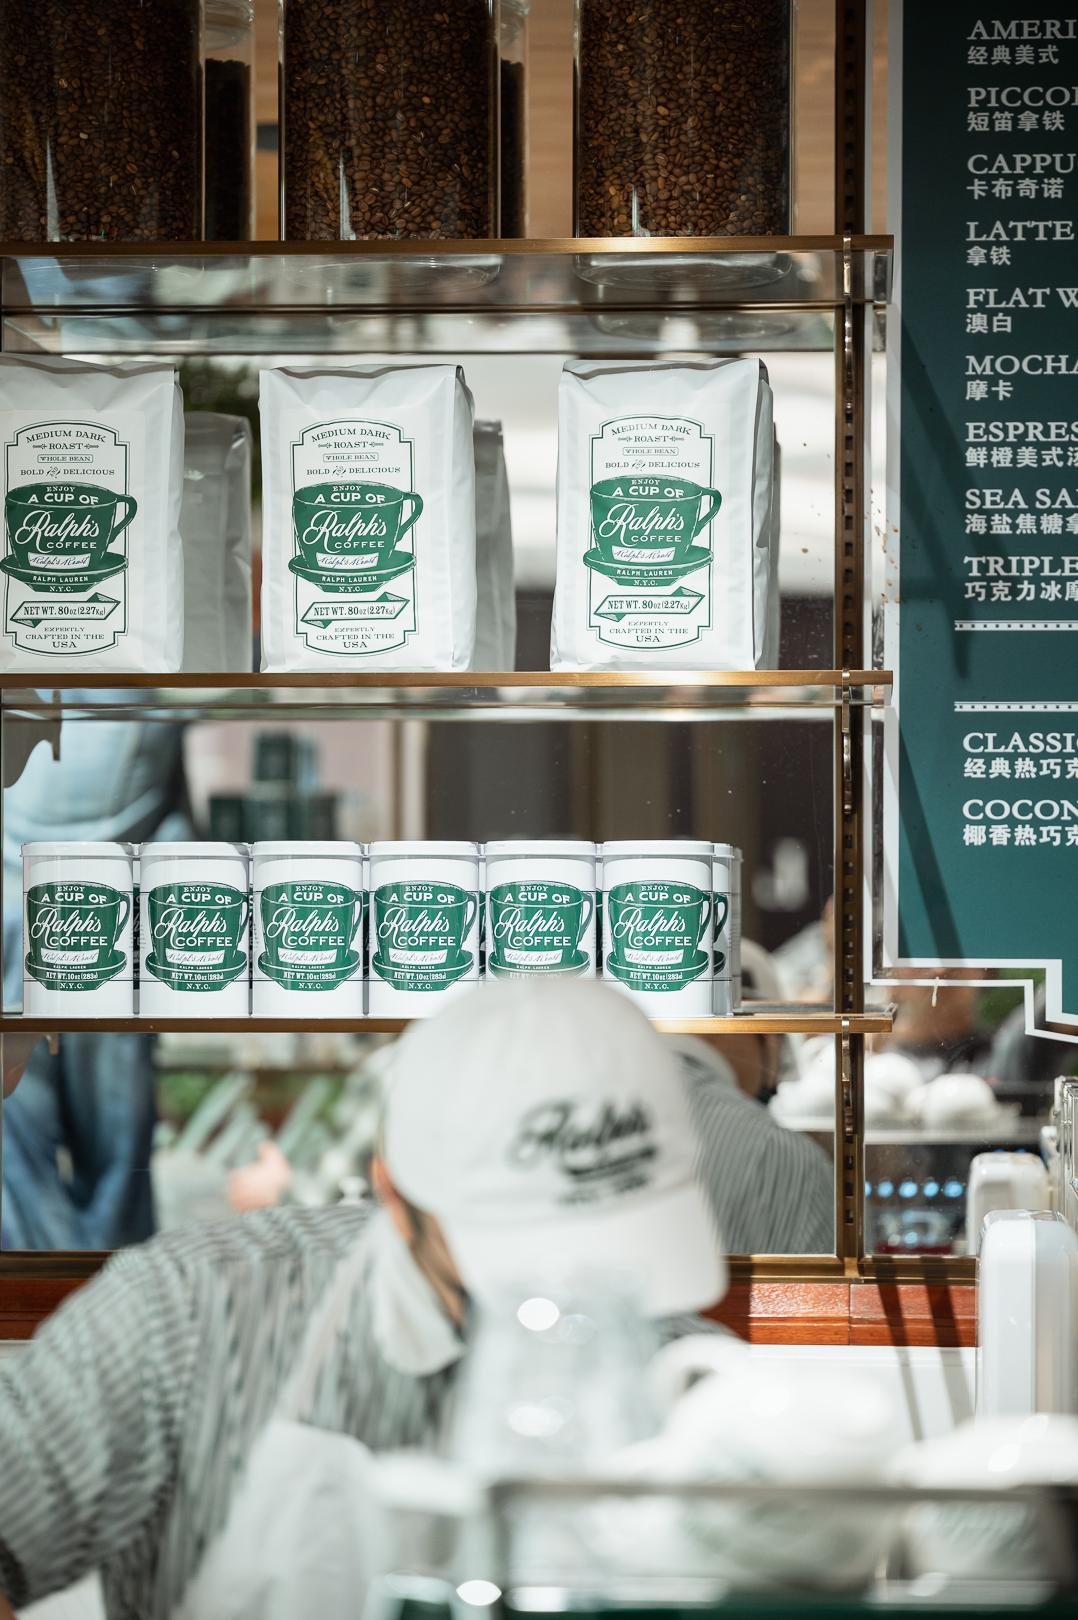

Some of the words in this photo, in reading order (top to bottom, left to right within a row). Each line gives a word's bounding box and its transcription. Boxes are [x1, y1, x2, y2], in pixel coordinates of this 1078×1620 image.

[966, 19, 1077, 40] AMERI
[967, 44, 1059, 65] 经典美式
[967, 110, 1065, 132] 短笛拿铁
[967, 153, 1076, 174] CAPPU
[966, 178, 1064, 200] 卡布奇诺
[966, 221, 1075, 241] LATTE
[966, 245, 1011, 266] 拿铁
[966, 287, 1050, 308] FLAT
[966, 313, 1012, 333] 澳白
[965, 379, 1013, 401] 摩卡
[26, 430, 72, 443] MEDIUM
[76, 430, 106, 442] DARK
[312, 429, 356, 442] MEDIUM
[360, 429, 391, 440] DARK
[612, 424, 657, 435] MEDIUM
[661, 424, 692, 435] DARK
[28, 495, 38, 503] A
[44, 494, 75, 502] CUP
[79, 495, 99, 504] OF
[314, 494, 325, 503] A
[331, 493, 361, 501] CUP
[366, 494, 385, 503] OF
[612, 487, 623, 496] A
[629, 486, 659, 495] CUP
[664, 488, 684, 498] OF
[965, 488, 1028, 509] SEA
[1035, 488, 1078, 509] SA
[15, 510, 99, 553] Ralph's
[302, 510, 386, 553] Ralph's
[599, 503, 684, 546] Ralph's
[963, 556, 1078, 577] TRIPLE
[24, 607, 40, 615] NET
[42, 607, 56, 615] WT.
[314, 607, 330, 616] NET
[332, 607, 346, 615] WT.
[608, 601, 624, 609] NET
[626, 601, 640, 609] WT.
[962, 732, 1078, 753] CLASSI
[962, 799, 1078, 820] COCON
[41, 893, 50, 902] A
[55, 893, 84, 901] CUP
[89, 894, 107, 904] OF
[166, 894, 176, 904] A
[182, 894, 211, 902] CUP
[215, 895, 232, 904] OF
[279, 893, 288, 902] A
[294, 892, 323, 901] CUP
[327, 894, 344, 903] OF
[389, 893, 398, 902] A
[404, 892, 433, 901] CUP
[437, 894, 455, 904] OF
[504, 893, 513, 902] A
[518, 892, 547, 901] CUP
[552, 894, 570, 904] OF
[624, 893, 634, 902] A
[640, 892, 668, 901] CUP
[673, 894, 691, 903] OF
[31, 907, 101, 948] Ralph's
[154, 908, 227, 949] Ralph's
[267, 907, 339, 948] Ralph's
[379, 907, 450, 948] Ralph's
[494, 907, 565, 949] Ralph's
[614, 907, 686, 949] Ralph's
[50, 937, 107, 945] COFFEE
[175, 937, 232, 946] COFFEE
[288, 936, 345, 946] COFFEE
[398, 936, 456, 946] COFFEE
[513, 937, 571, 946] COFFEE
[634, 937, 692, 946] COFFEE
